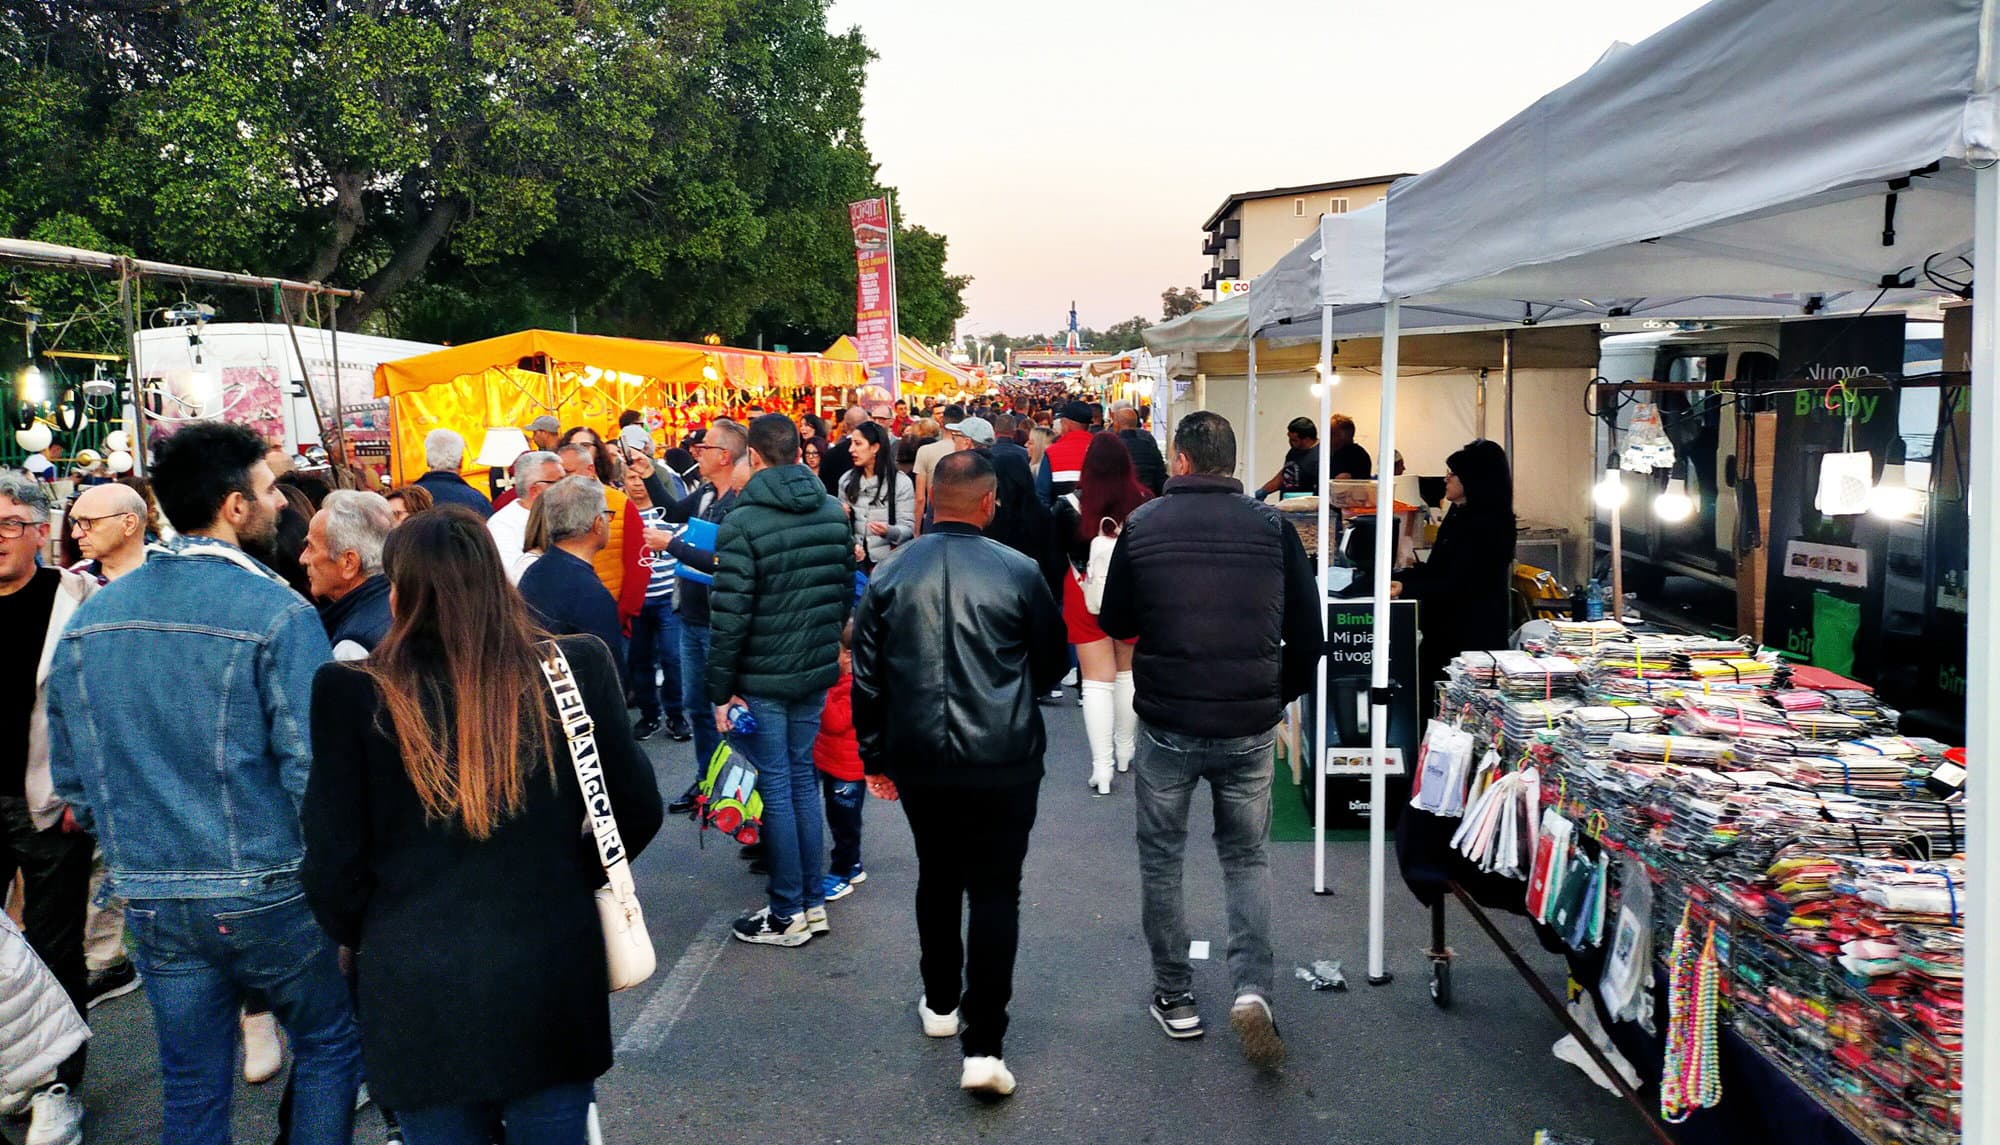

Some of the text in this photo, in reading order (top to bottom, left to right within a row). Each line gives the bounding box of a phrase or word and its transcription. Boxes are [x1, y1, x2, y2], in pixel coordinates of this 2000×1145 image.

[1336, 613, 1375, 625] Bimb
[1333, 631, 1375, 646] Mi pia
[1333, 650, 1375, 665] ti vogl
